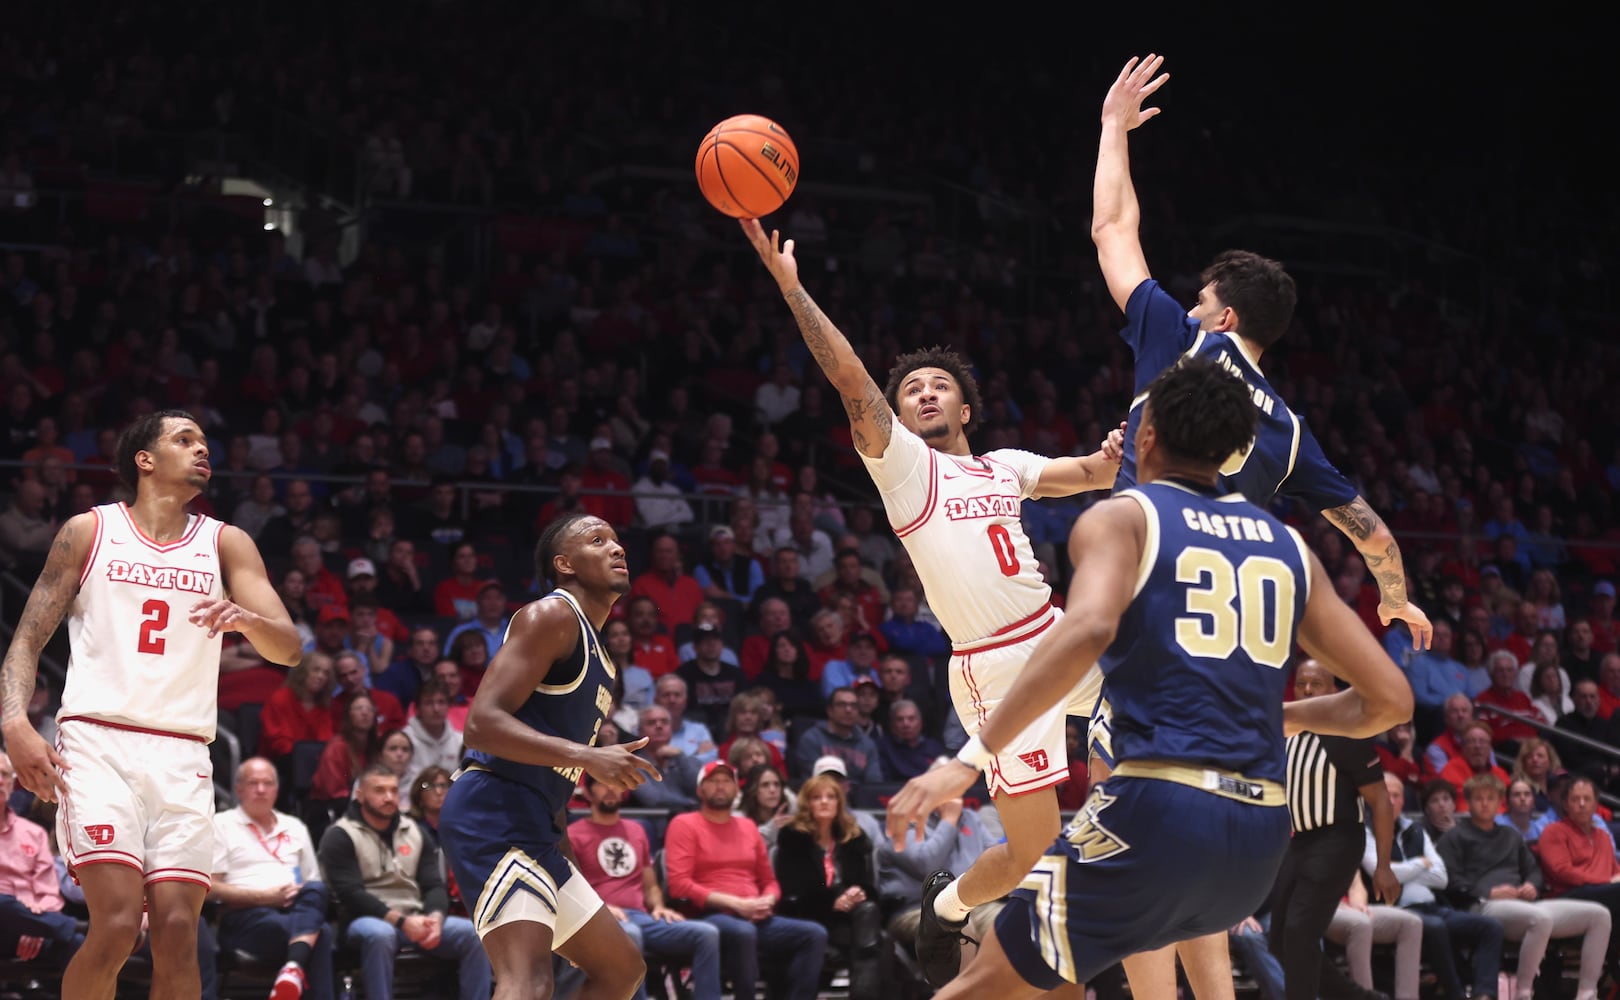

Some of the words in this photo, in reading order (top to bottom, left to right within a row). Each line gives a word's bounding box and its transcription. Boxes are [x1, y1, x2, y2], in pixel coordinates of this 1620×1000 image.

[761, 142, 796, 186] ELITE
[1182, 507, 1275, 543] CASTRO
[987, 524, 1020, 577] 0
[106, 559, 214, 595] DAYTON
[138, 598, 170, 655] 2
[1175, 546, 1296, 669] 30
